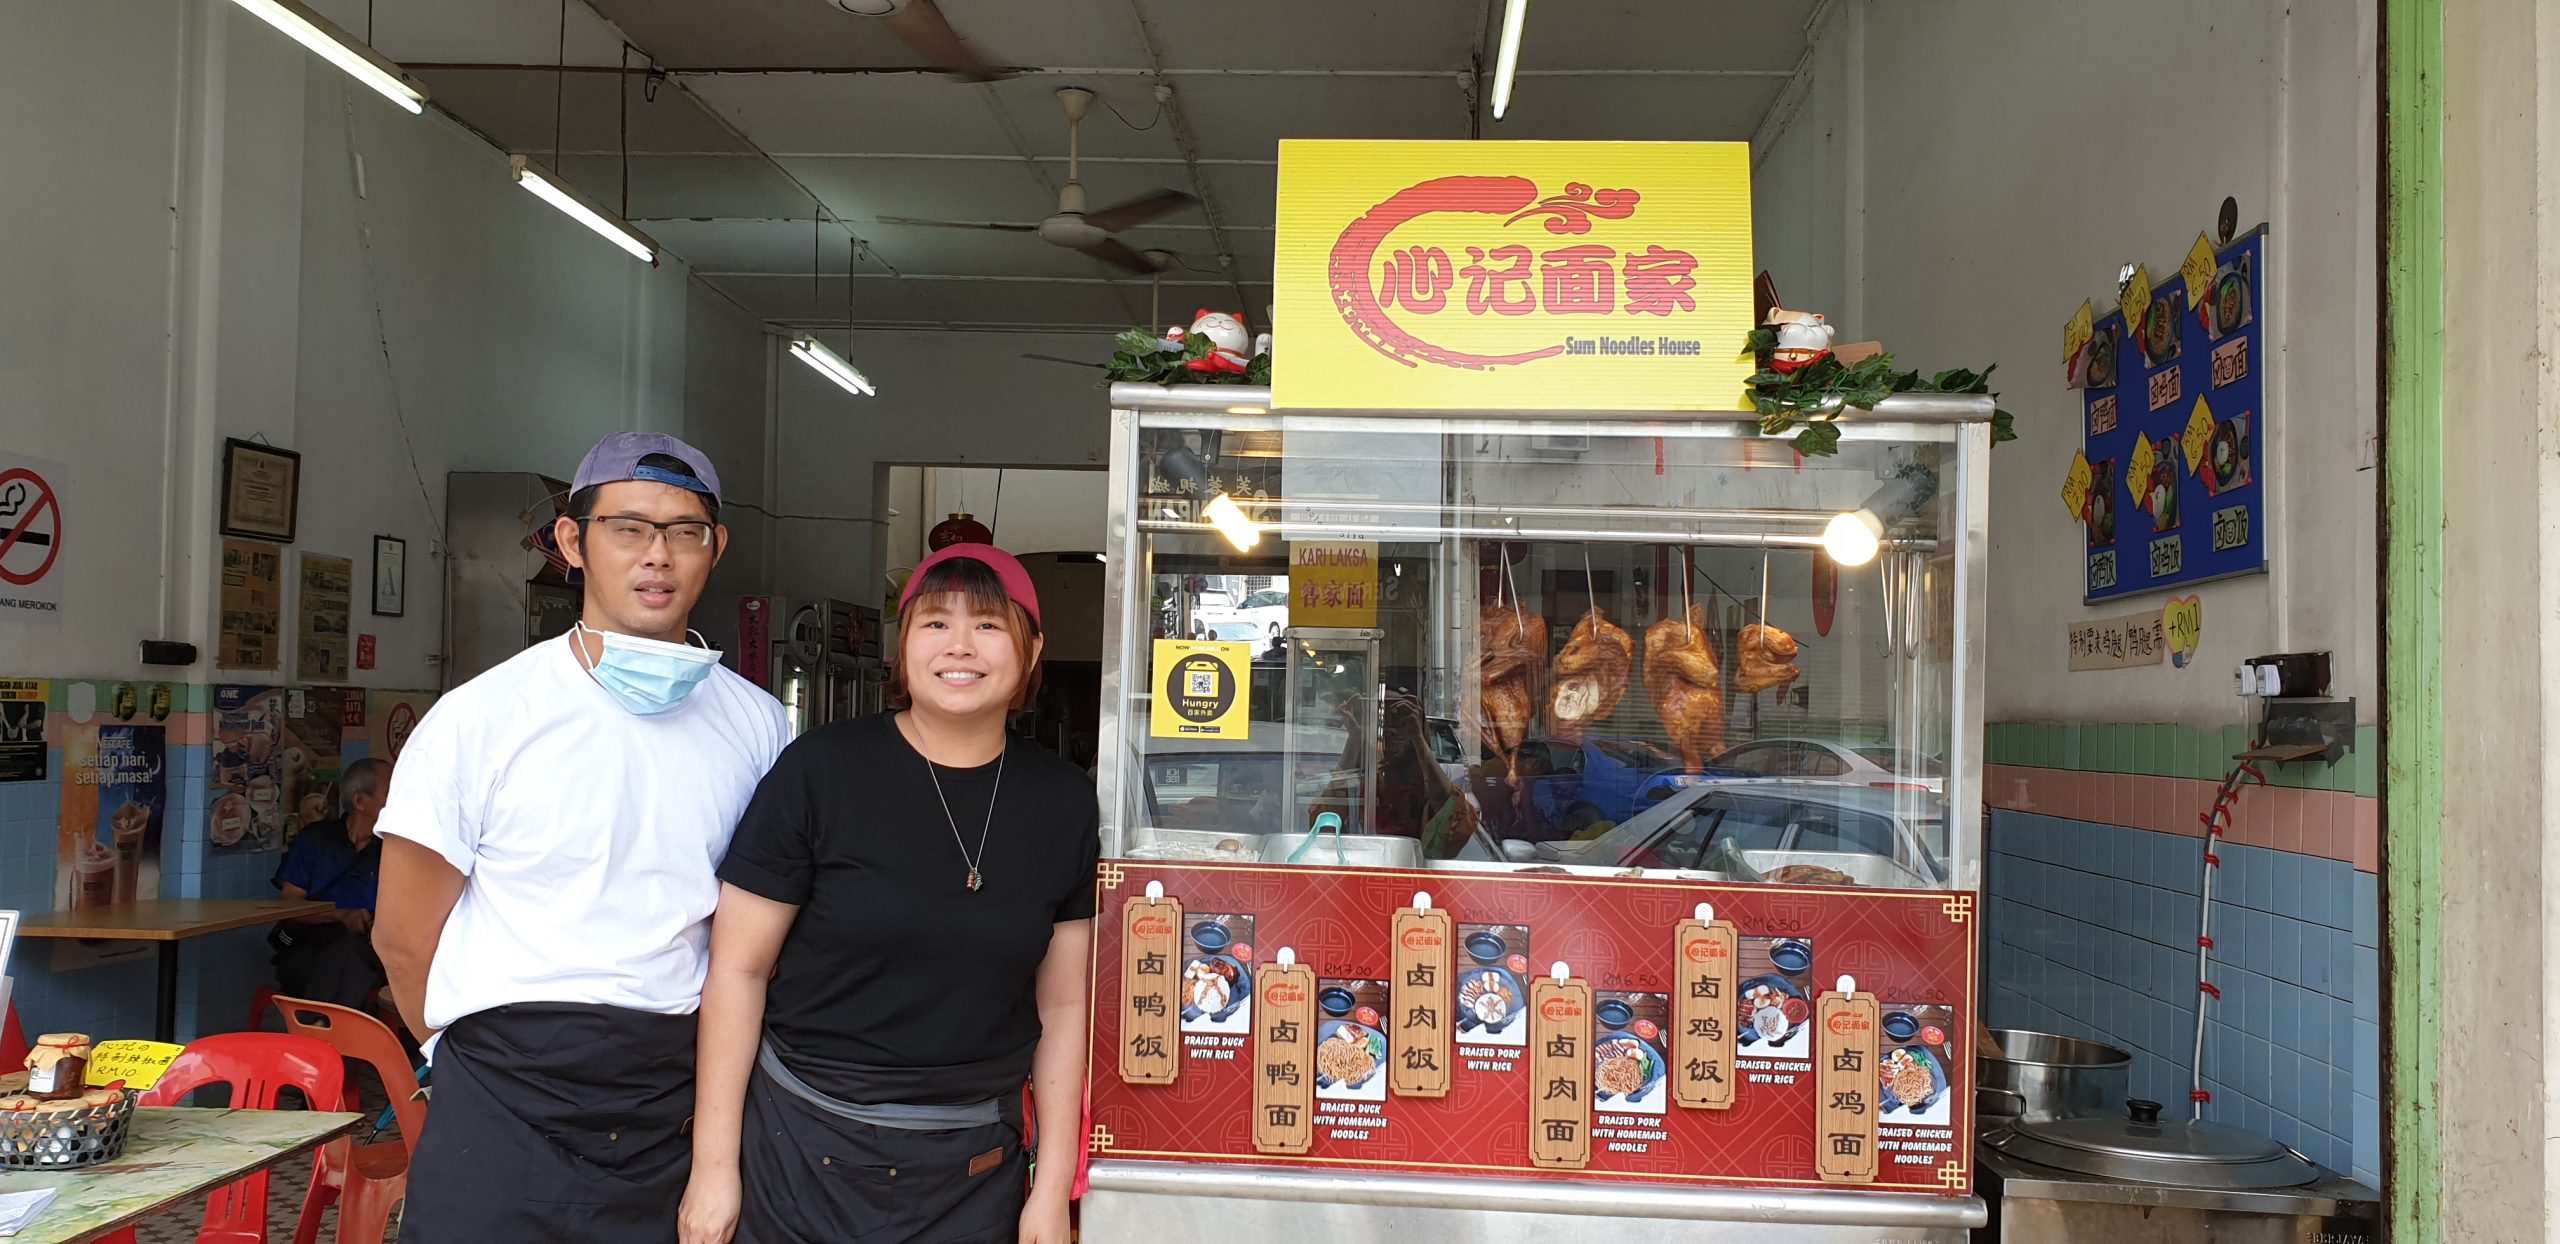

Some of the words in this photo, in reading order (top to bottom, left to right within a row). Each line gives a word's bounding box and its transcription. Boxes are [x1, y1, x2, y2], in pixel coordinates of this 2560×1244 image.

[1379, 244, 1699, 317] 心记面家
[1566, 336, 1596, 356] Sum
[1599, 336, 1655, 356] Noodles
[1658, 336, 1701, 356] House
[1299, 548, 1327, 568] KARI
[1329, 548, 1368, 568] LAKSA
[18, 600, 58, 612] MEROKOK
[1182, 699, 1219, 710] Hungry
[80, 752, 118, 773] setiap
[122, 752, 150, 770] hari,
[75, 770, 113, 788] setiap
[117, 768, 153, 784] masa!
[1130, 951, 1167, 1059] 卤鸭饭
[1401, 963, 1439, 1071] 卤肉饭
[1685, 975, 1724, 1084] 卤鸡饭
[1184, 1036, 1219, 1047] BRAISED
[1221, 1037, 1245, 1048] DUCK
[1190, 1049, 1213, 1059] WITH
[1215, 1050, 1235, 1060] RICE
[1459, 1047, 1495, 1058] BRAISED
[1497, 1048, 1521, 1059] PORK
[1467, 1060, 1490, 1071] WITH
[1492, 1061, 1513, 1072] RICE
[1735, 1060, 1772, 1070] BRAISED
[1773, 1061, 1812, 1072] CHICKEN
[1264, 1019, 1301, 1128] 卤鸭面
[1748, 1073, 1773, 1084] WITH
[1774, 1074, 1795, 1085] RICE
[1541, 1034, 1579, 1142] 卤肉面
[1320, 1102, 1356, 1113] BRAISED
[1358, 1104, 1382, 1114] DUCK
[1828, 1048, 1866, 1157] 卤鸡面
[1313, 1115, 1336, 1125] WITH
[1337, 1116, 1388, 1128] HOMEMADE
[1599, 1115, 1635, 1126] BRAISED
[1637, 1117, 1661, 1128] PORK
[1330, 1129, 1370, 1140] NOODLES
[1591, 1128, 1615, 1139] WITH
[1616, 1129, 1668, 1141] HOMEMADE
[1915, 1128, 1953, 1139] CHICKEN
[1608, 1142, 1648, 1153] NOODLES
[1901, 1141, 1953, 1153] HOMEMADE
[1893, 1154, 1934, 1165] NOODLES
